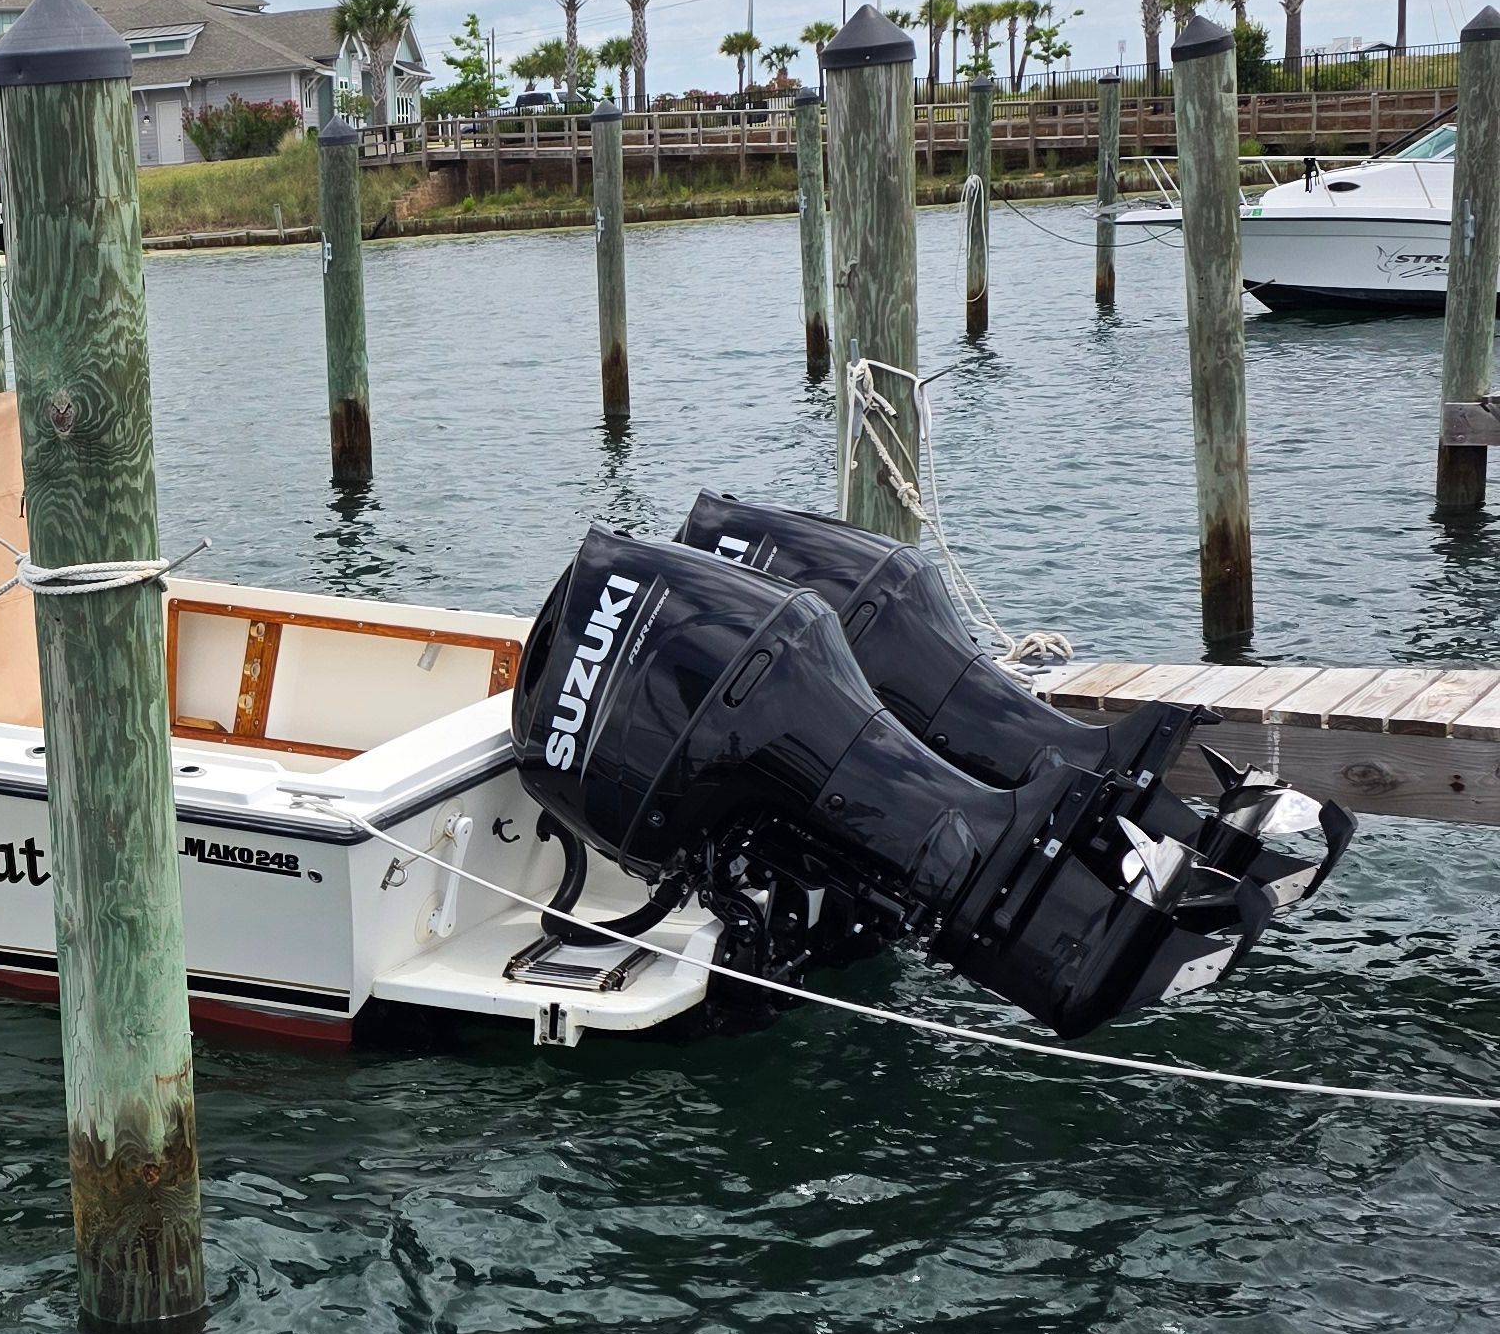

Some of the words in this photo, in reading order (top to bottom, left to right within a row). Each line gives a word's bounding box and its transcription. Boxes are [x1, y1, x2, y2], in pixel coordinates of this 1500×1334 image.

[545, 574, 640, 771] SUZUKI
[180, 837, 255, 864] MAKO
[255, 849, 300, 871] 248
